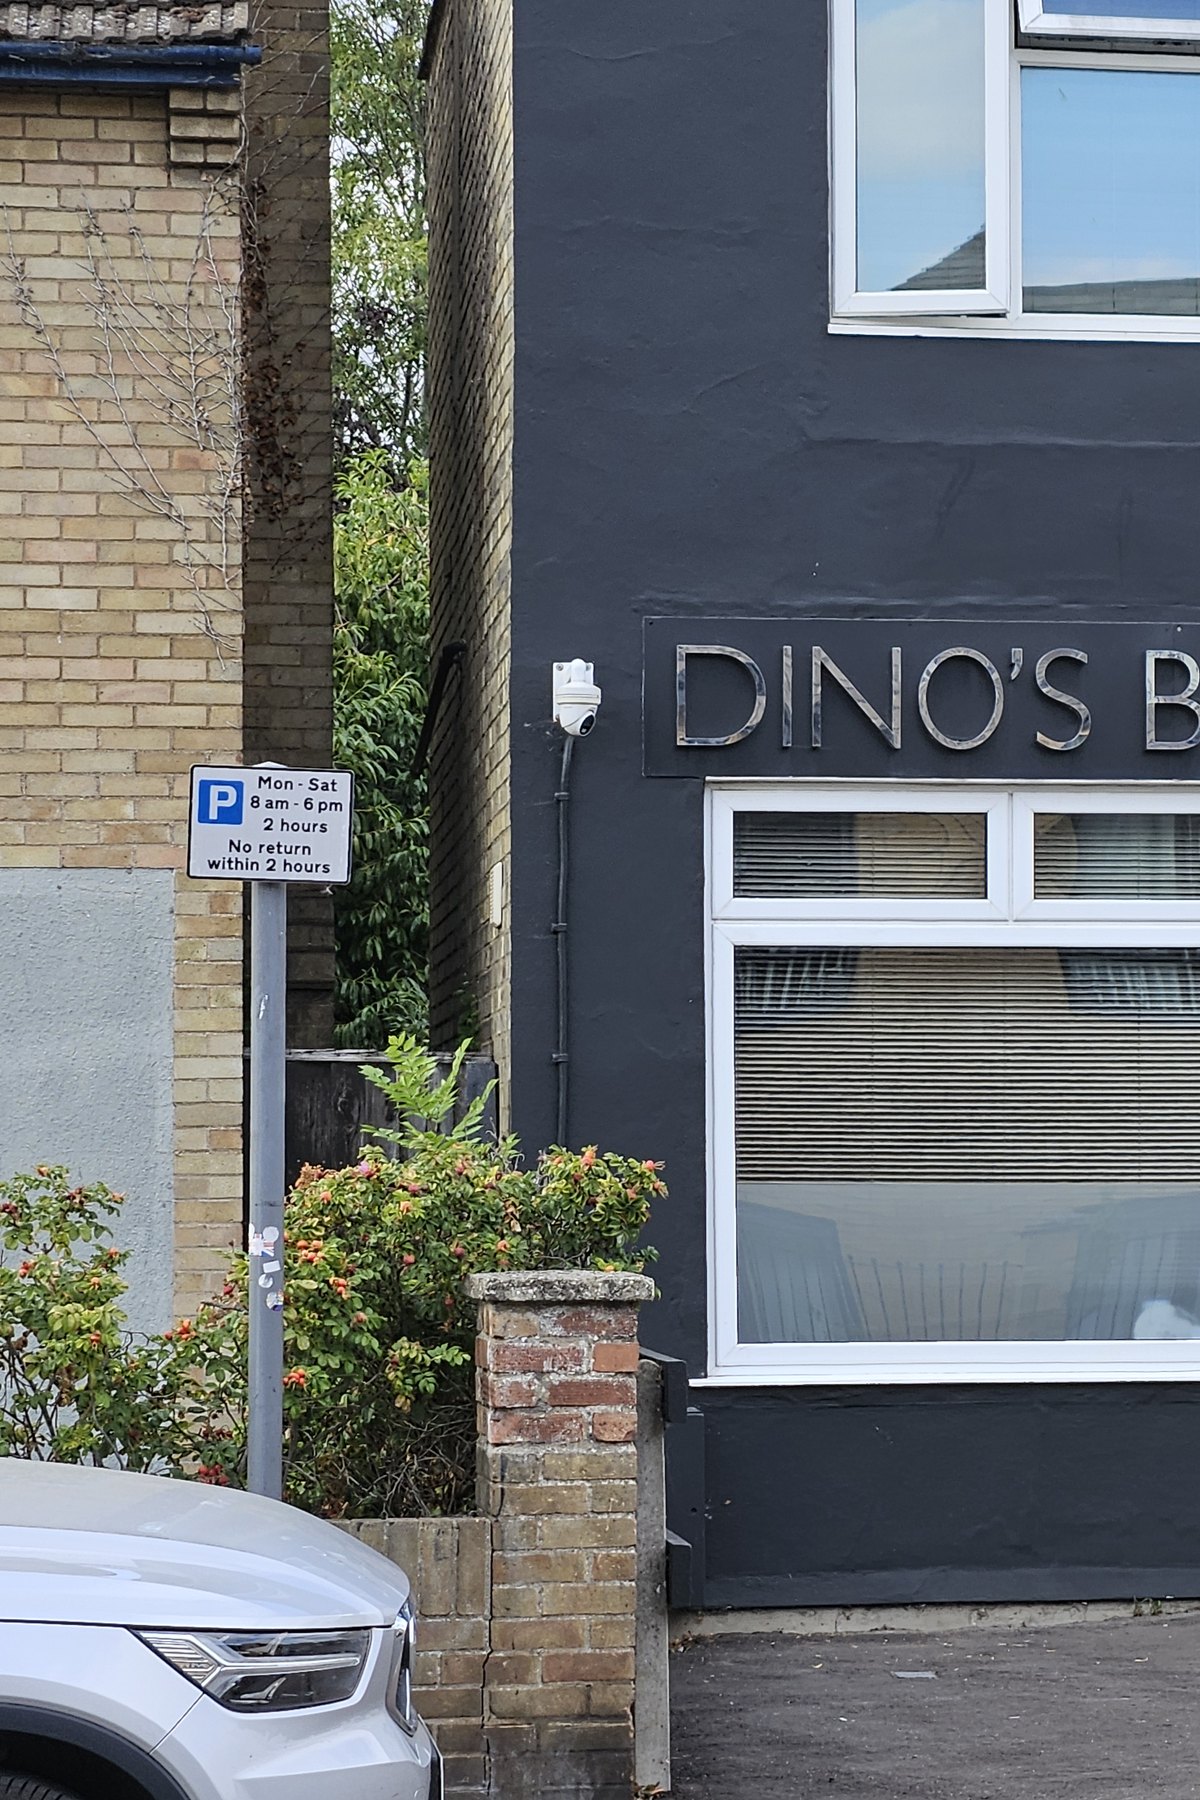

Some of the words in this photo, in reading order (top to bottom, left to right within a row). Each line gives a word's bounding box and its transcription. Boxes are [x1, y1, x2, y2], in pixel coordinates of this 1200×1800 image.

[676, 643, 1092, 752] DINO'S
[257, 776, 294, 791] Mon
[307, 777, 338, 792] Sat
[208, 785, 238, 820] P
[263, 818, 273, 831] 2
[280, 818, 328, 833] hours
[228, 839, 252, 853] No
[258, 841, 312, 855] return
[208, 857, 260, 871] within
[266, 858, 276, 872] 2
[283, 859, 331, 874] hours
